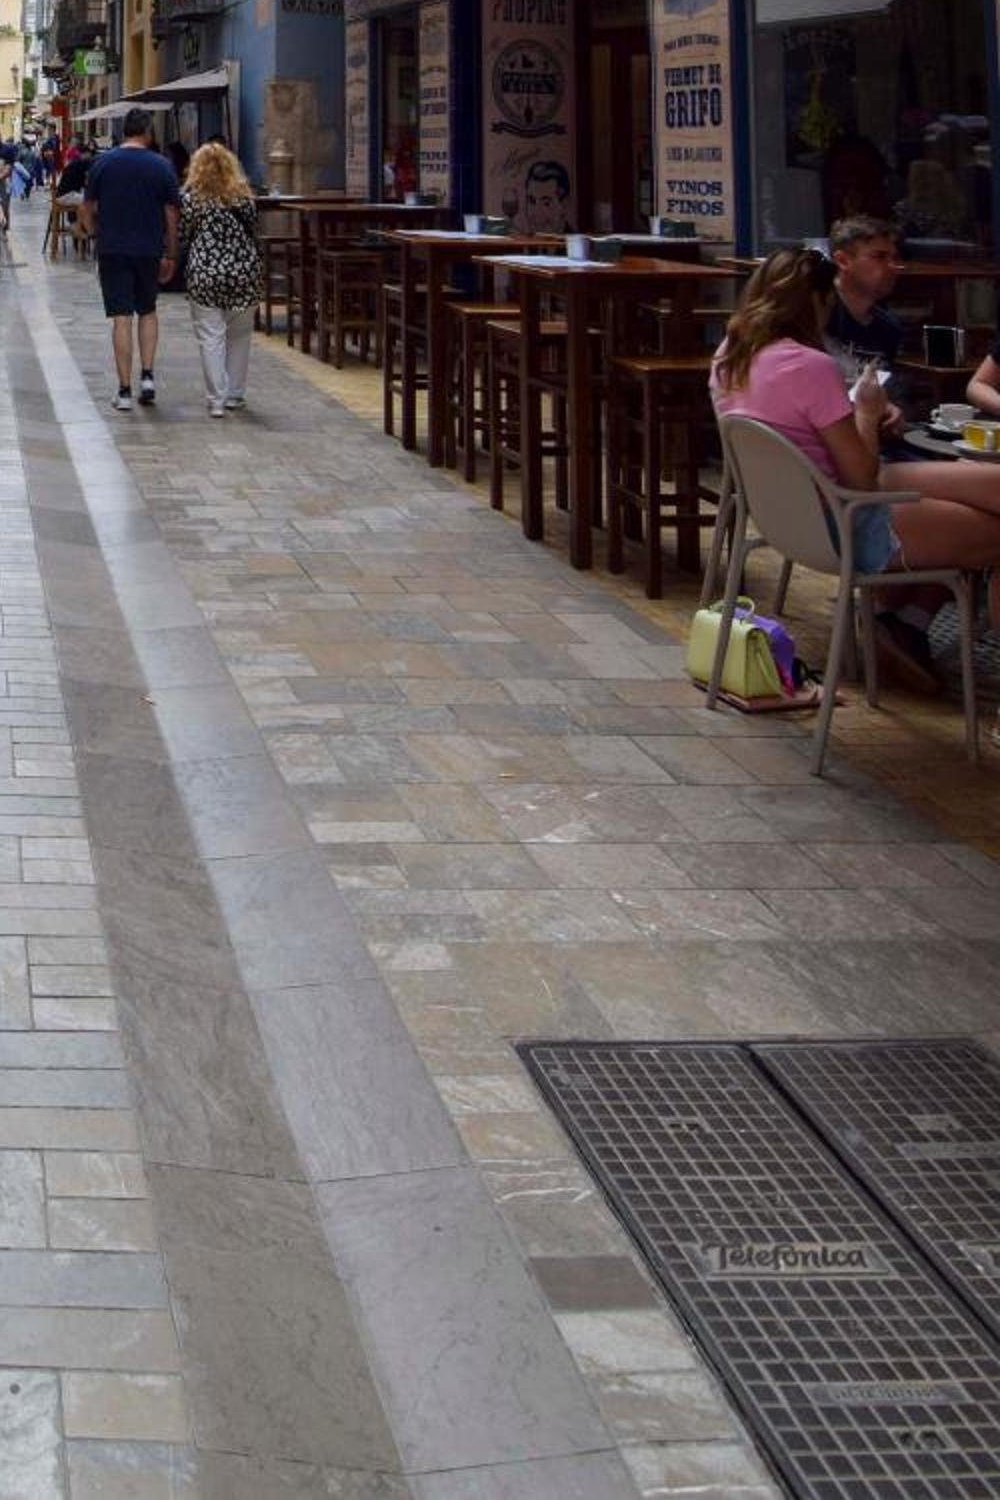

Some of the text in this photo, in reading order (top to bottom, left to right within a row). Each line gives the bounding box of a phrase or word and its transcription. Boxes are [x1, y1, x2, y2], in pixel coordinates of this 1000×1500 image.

[665, 88, 722, 128] GRIFO
[665, 180, 722, 196] VINOS
[666, 199, 723, 216] FINOS
